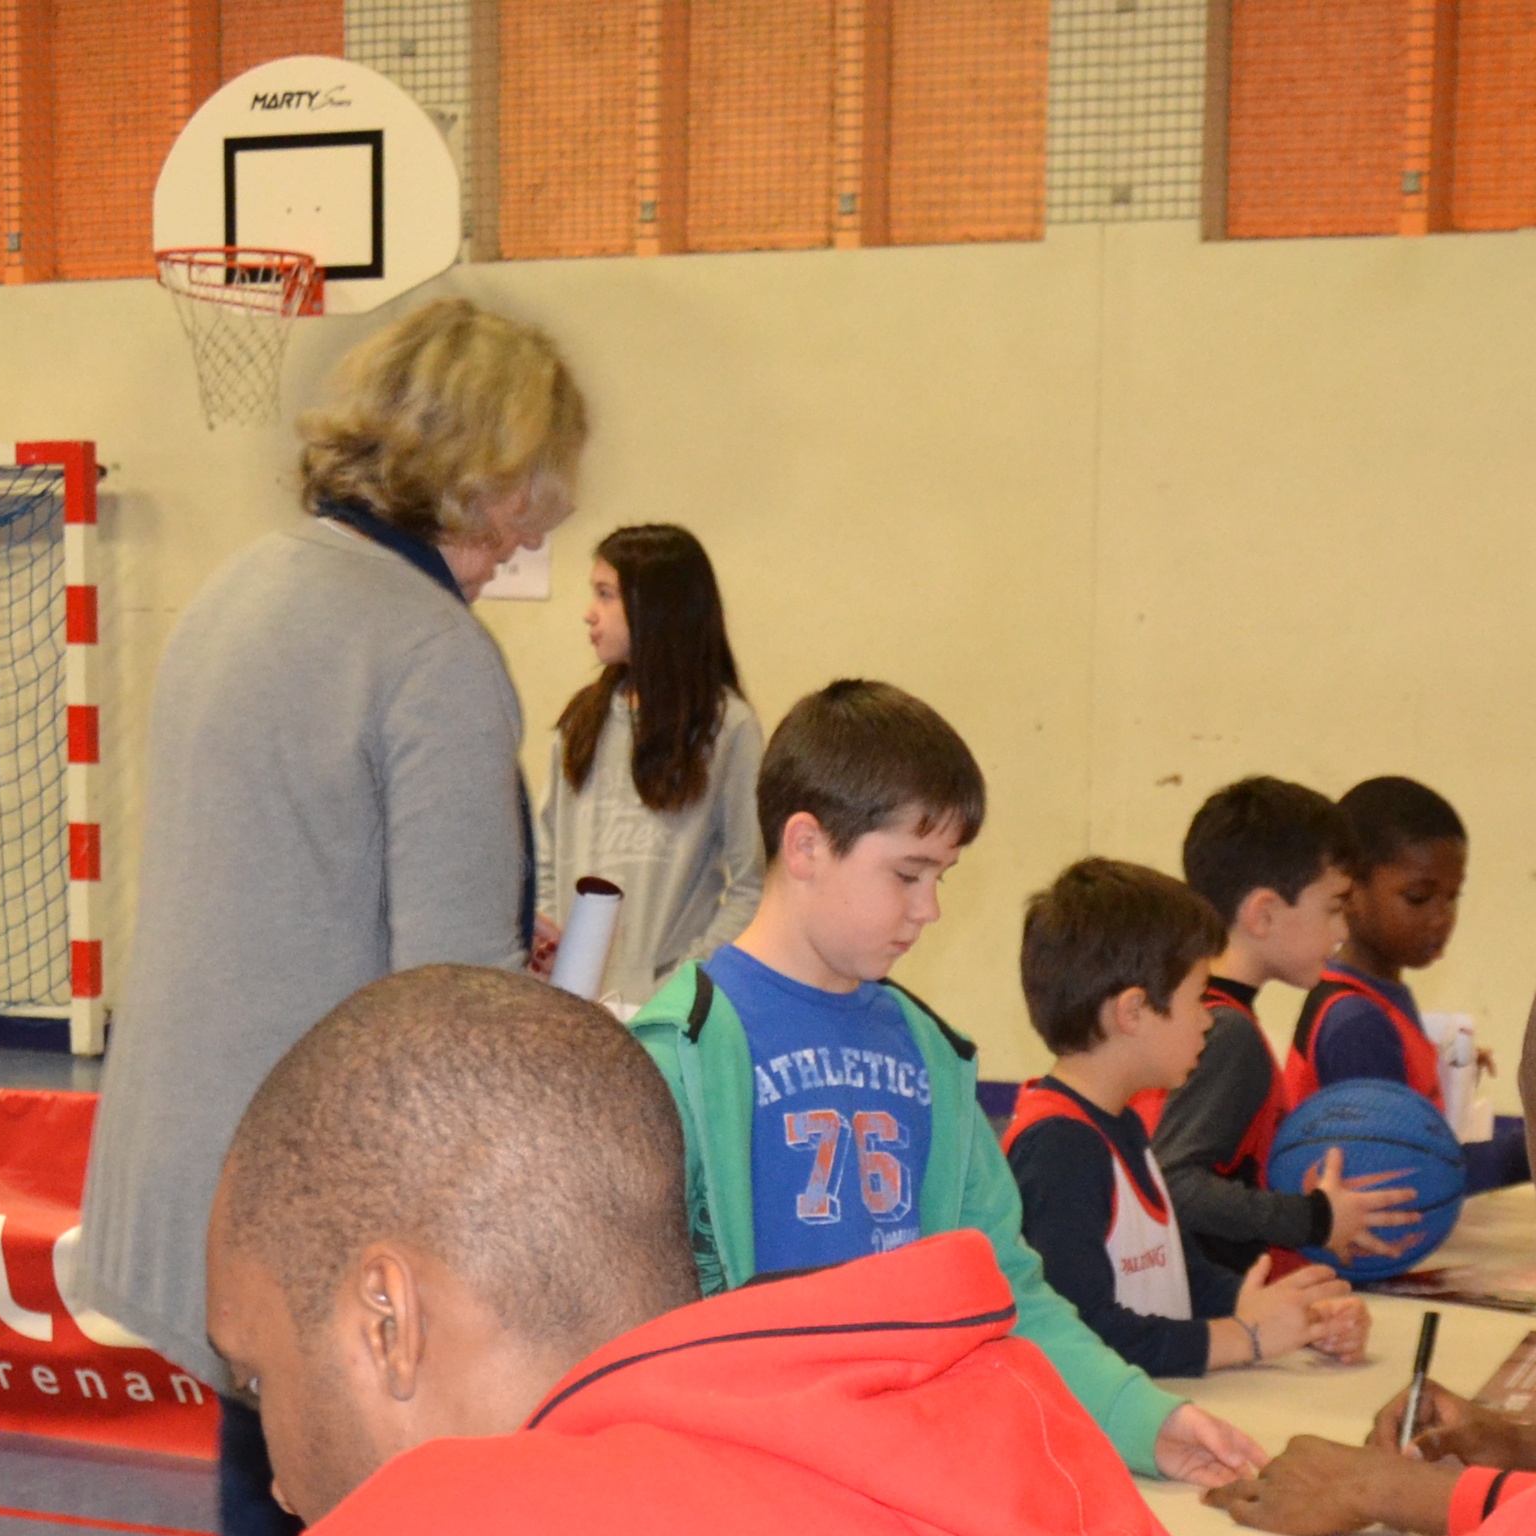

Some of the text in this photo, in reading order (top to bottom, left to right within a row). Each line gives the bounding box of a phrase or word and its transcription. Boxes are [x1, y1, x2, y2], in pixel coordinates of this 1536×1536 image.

[251, 90, 319, 110] MARTY
[754, 1047, 932, 1106] ATHLETICS
[783, 1108, 913, 1225] 76
